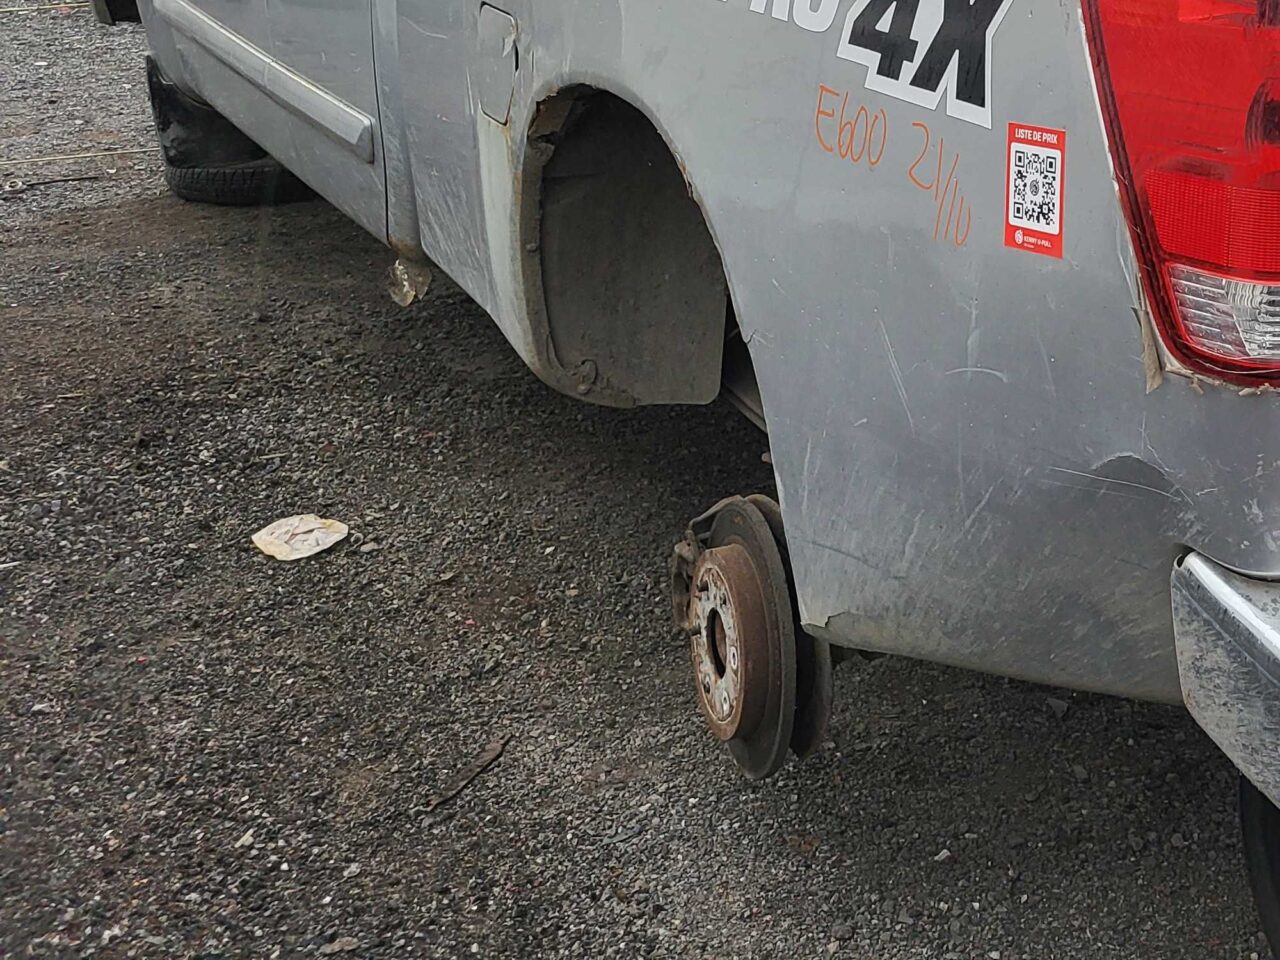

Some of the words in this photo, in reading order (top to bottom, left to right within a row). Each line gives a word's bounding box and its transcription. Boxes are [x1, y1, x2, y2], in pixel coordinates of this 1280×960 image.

[1015, 128, 1033, 140] LISTE
[1032, 131, 1042, 141] DE
[1042, 132, 1058, 145] PRIX
